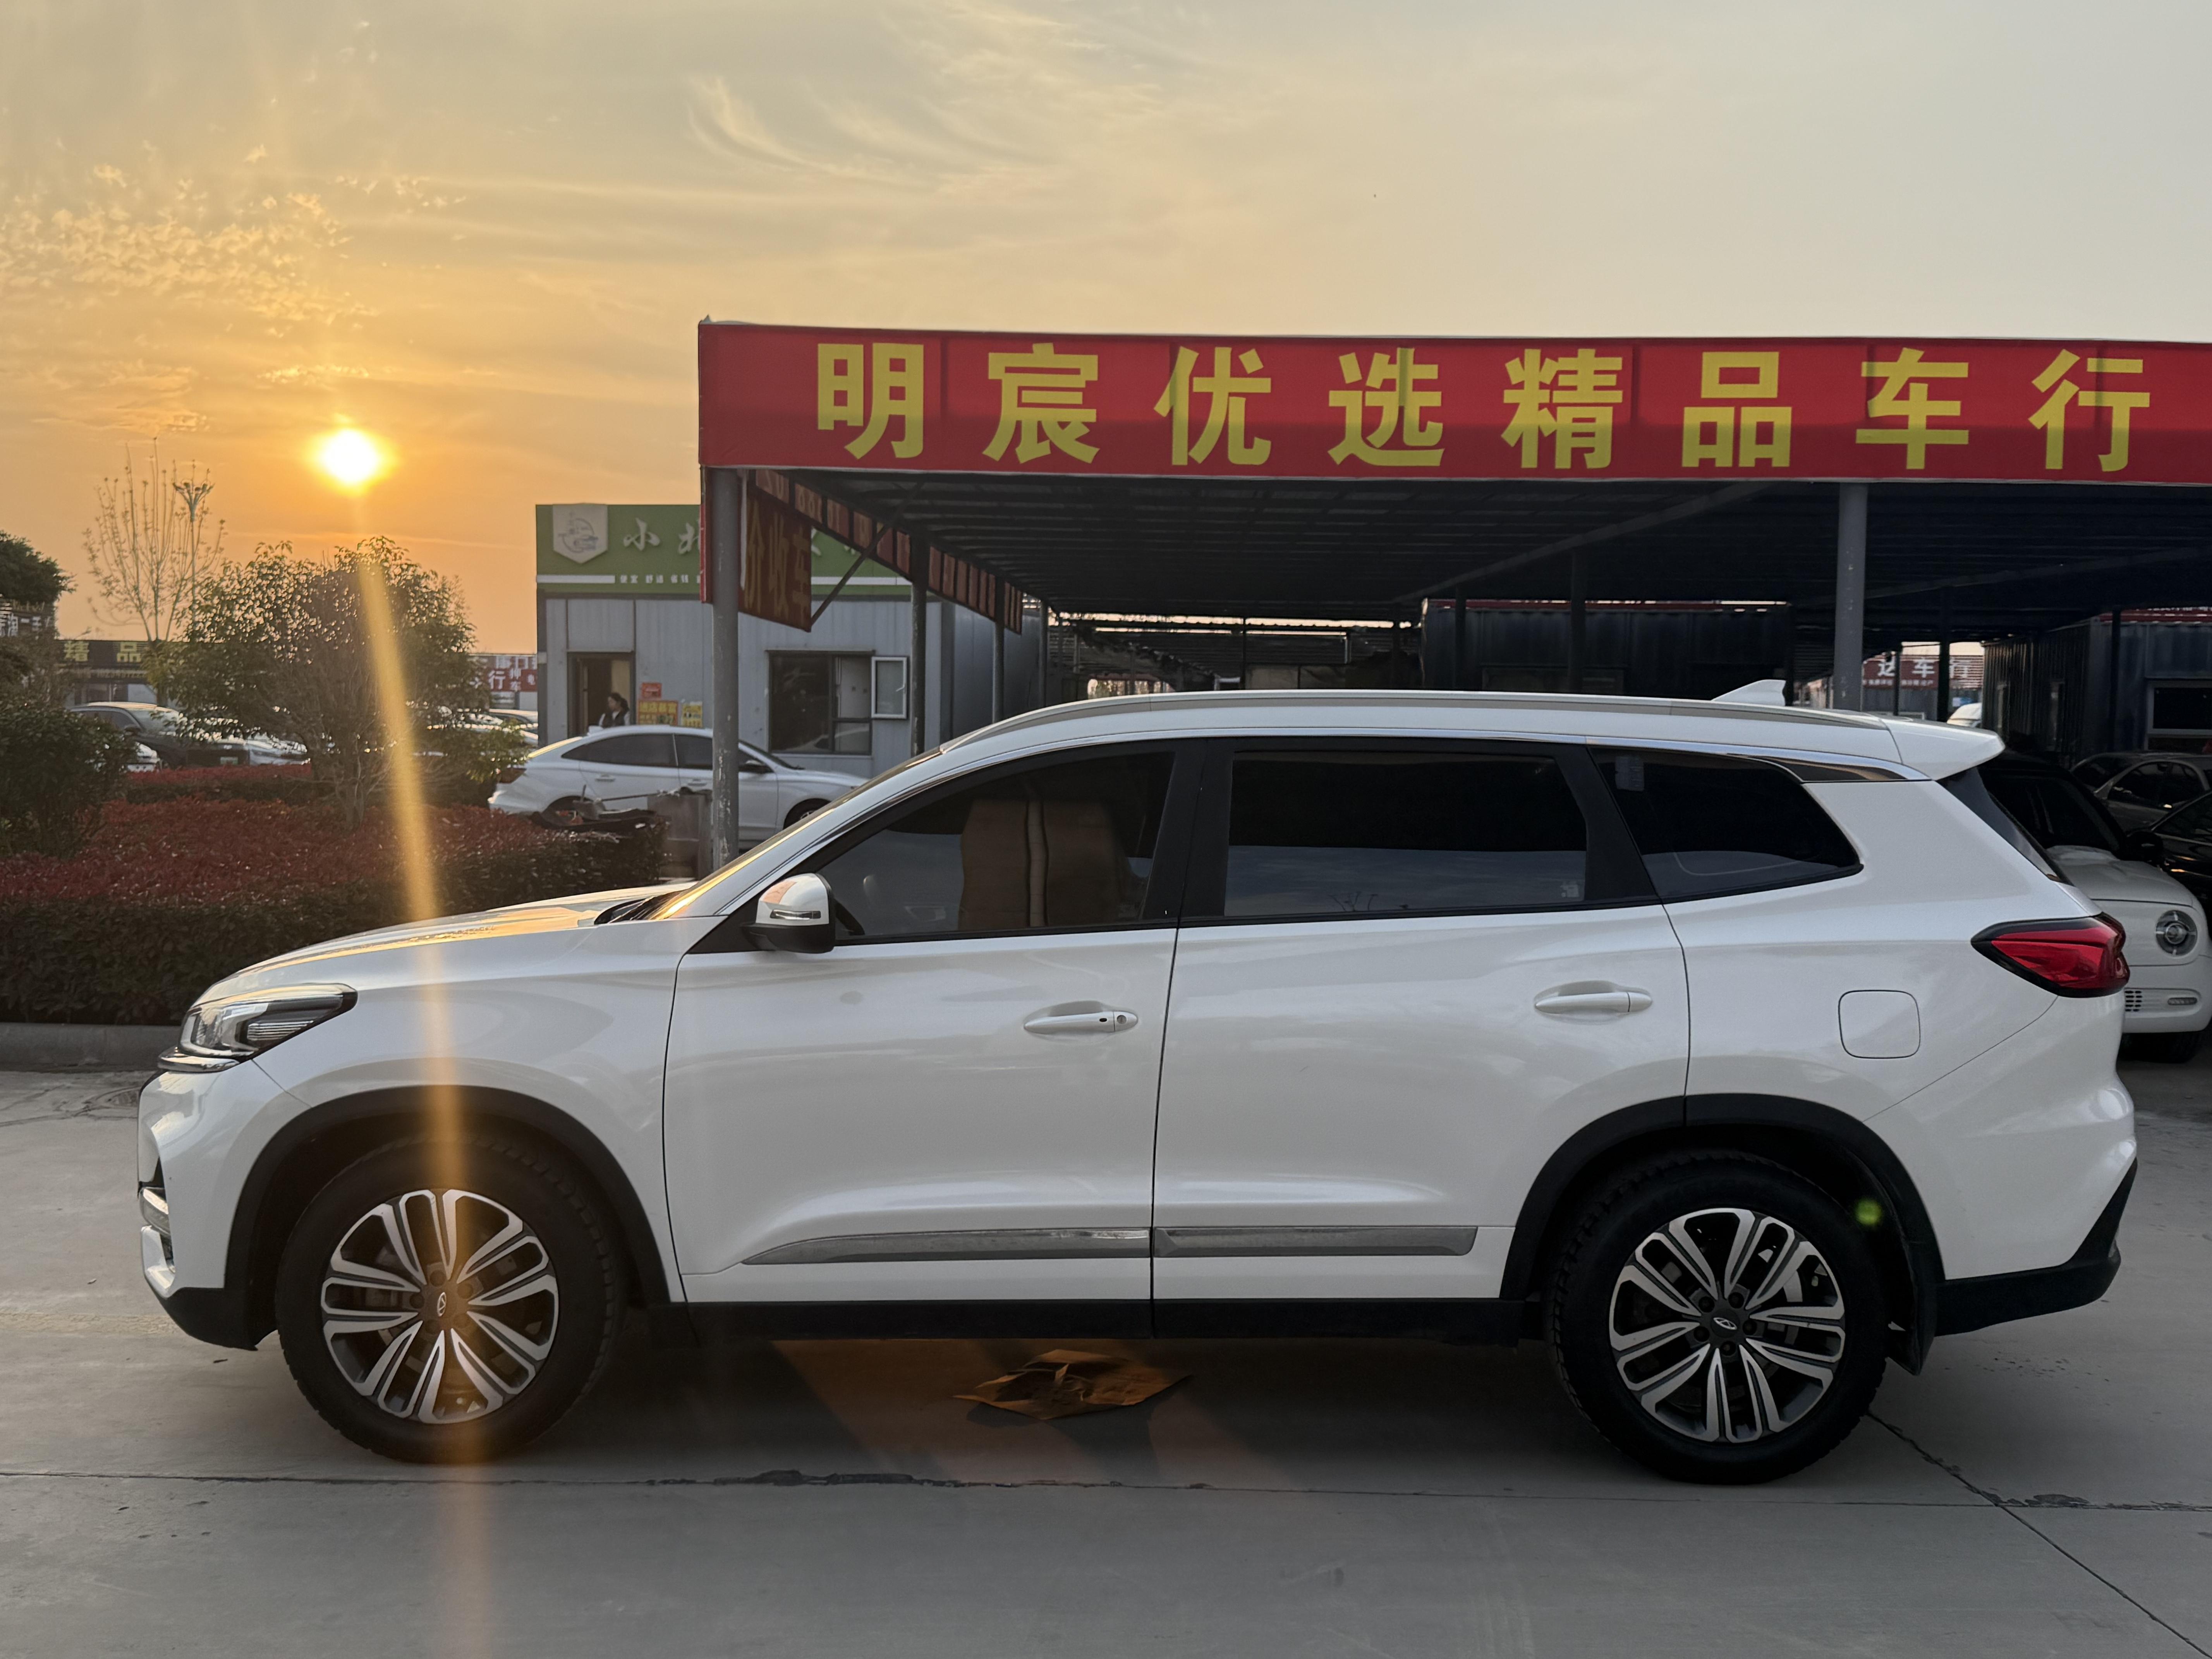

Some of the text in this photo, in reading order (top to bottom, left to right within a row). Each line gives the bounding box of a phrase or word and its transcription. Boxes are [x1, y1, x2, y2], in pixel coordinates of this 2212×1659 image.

[817, 343, 2150, 472] 明宸优选精品车行
